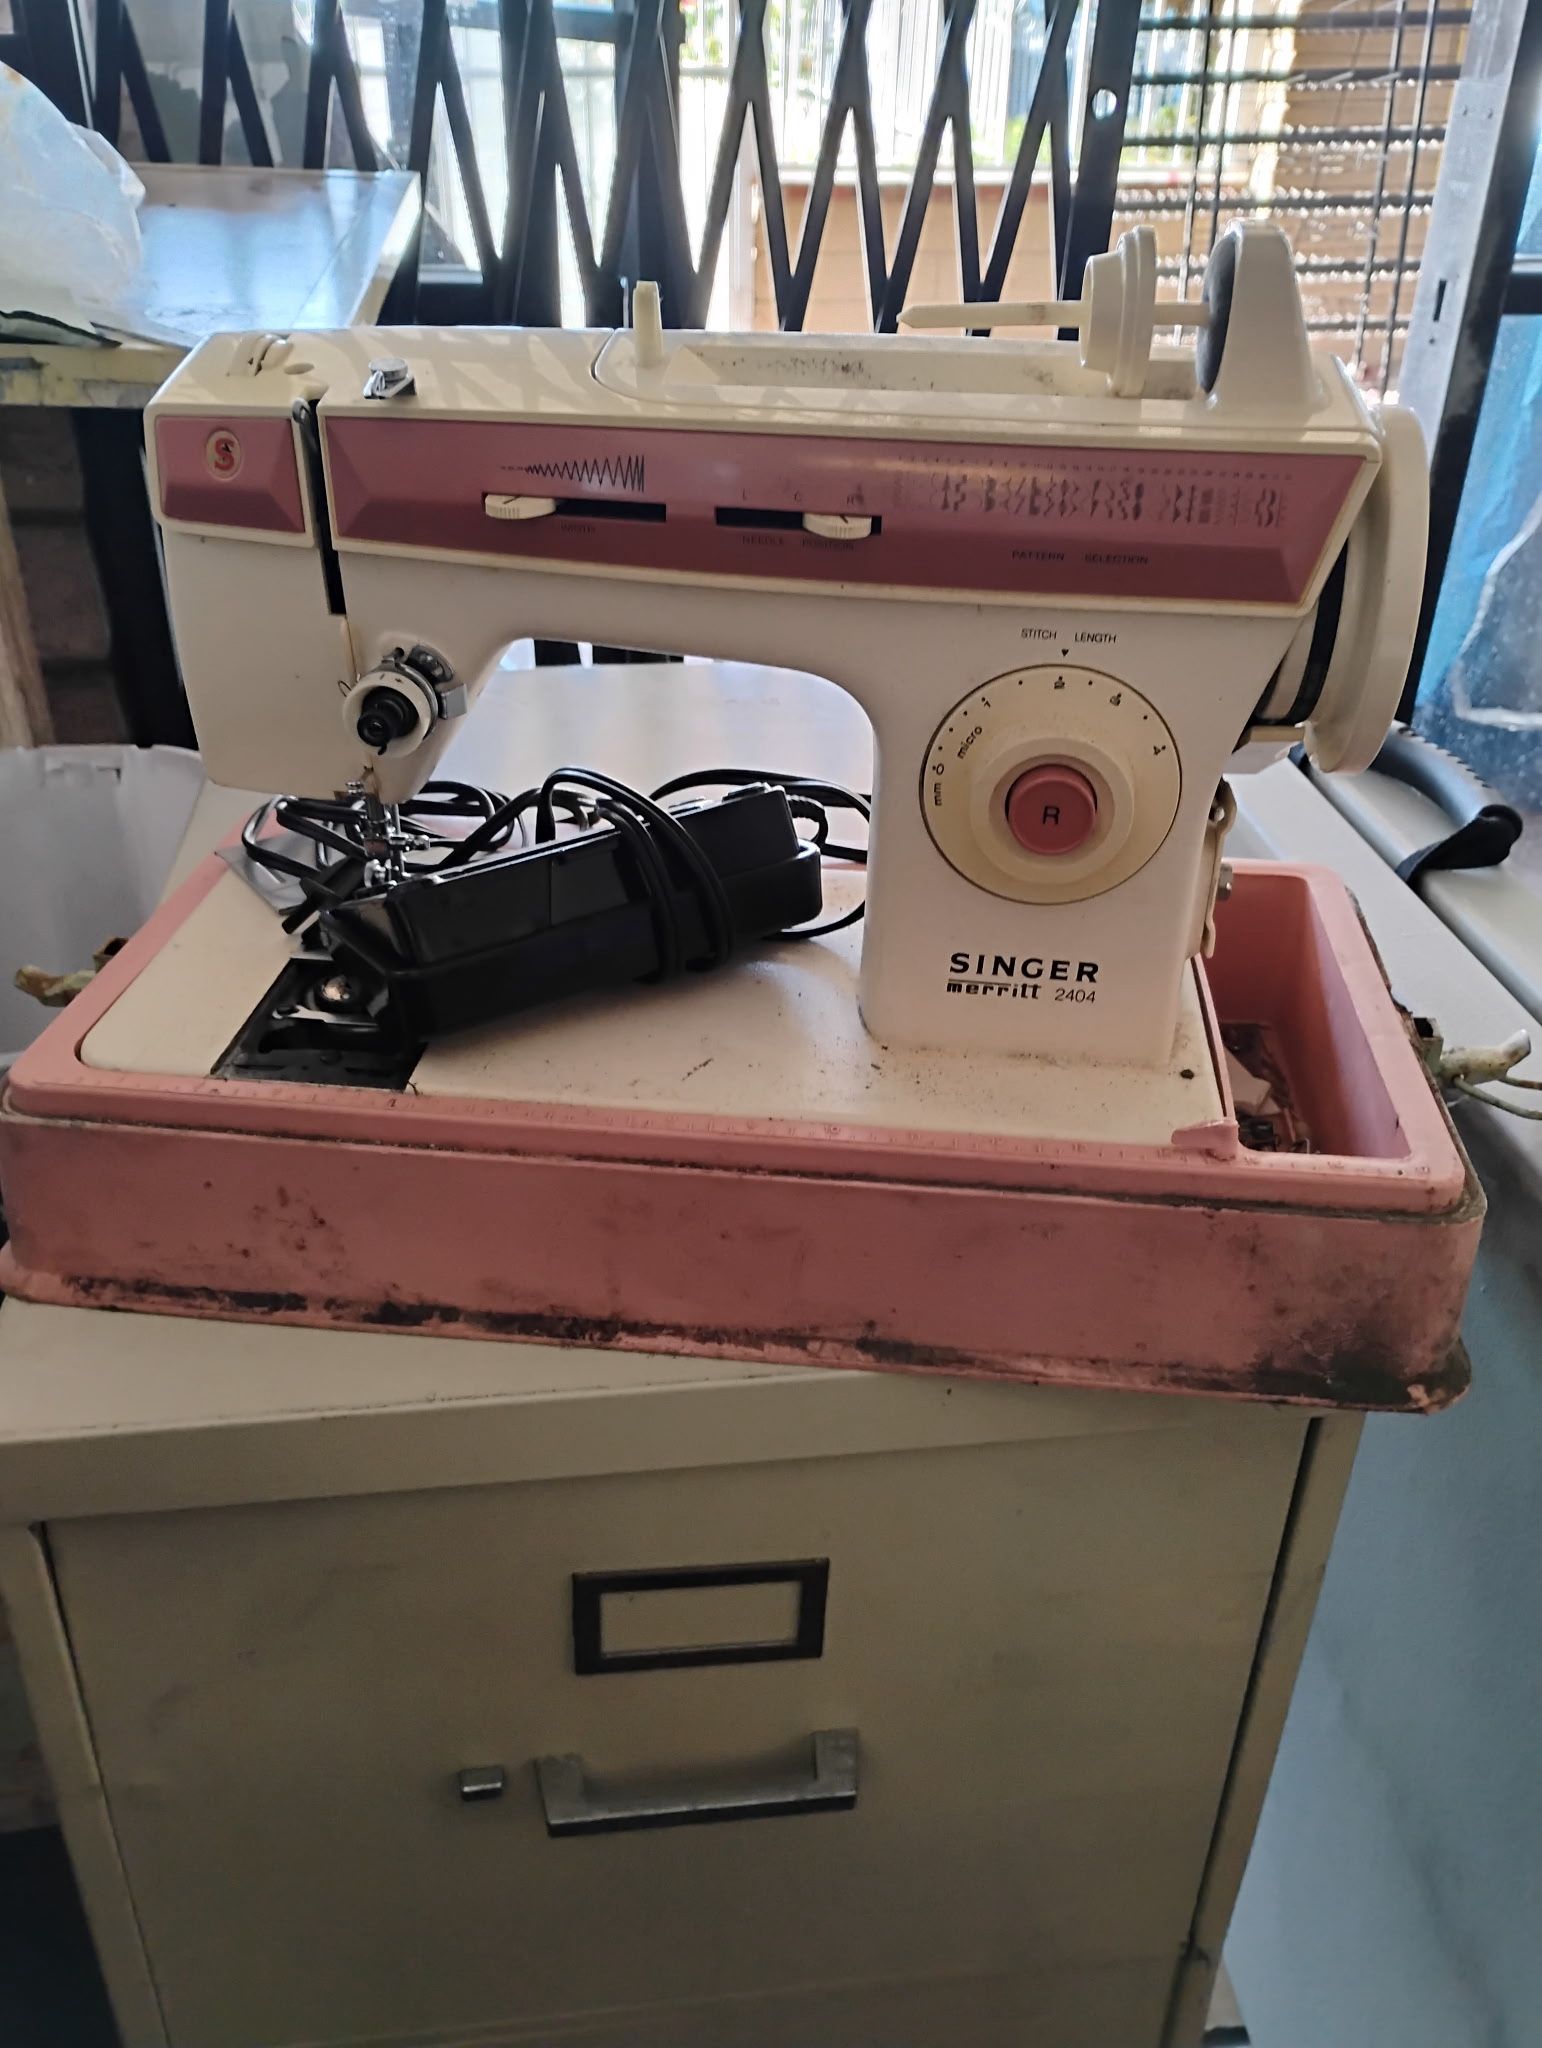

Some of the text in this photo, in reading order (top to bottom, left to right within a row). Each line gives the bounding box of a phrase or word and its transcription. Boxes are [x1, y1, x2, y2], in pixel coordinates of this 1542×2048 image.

[1011, 550, 1149, 565] PATTERN SELECTION
[1021, 628, 1117, 643] STITCH LENGTH
[957, 726, 983, 759] micro
[934, 782, 943, 806] mm
[1042, 805, 1060, 825] R
[949, 952, 1099, 983] SINGER
[947, 982, 1096, 1003] merritt 2404
